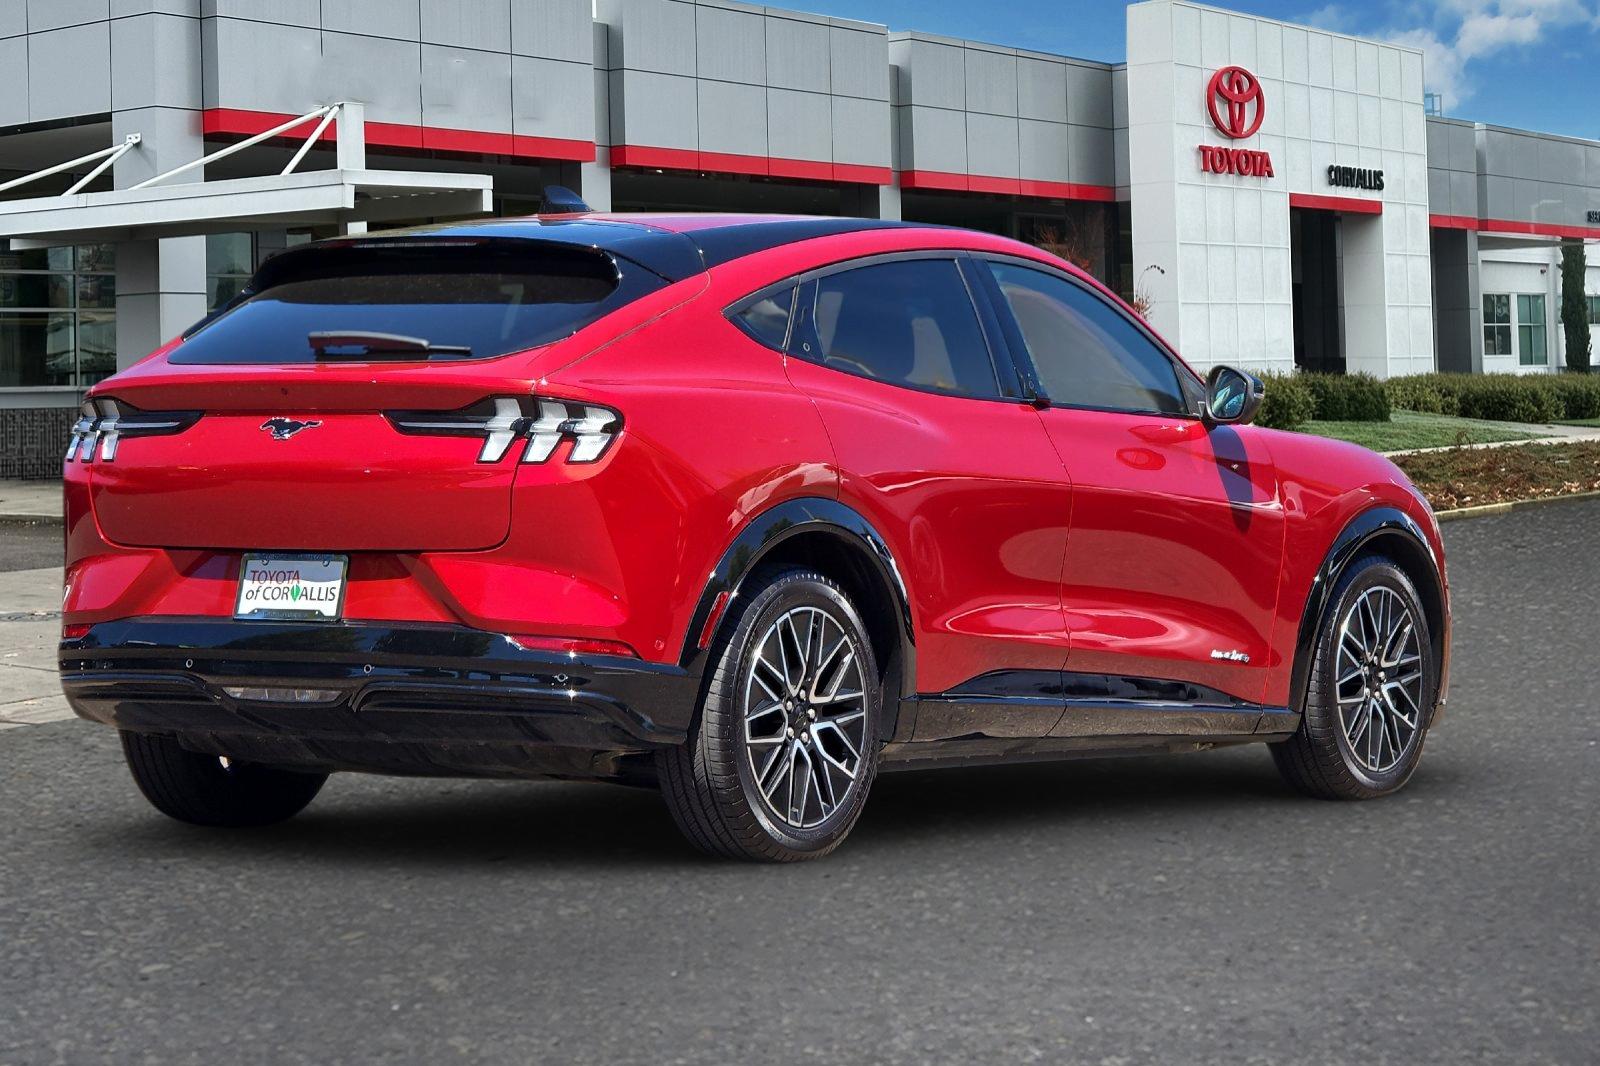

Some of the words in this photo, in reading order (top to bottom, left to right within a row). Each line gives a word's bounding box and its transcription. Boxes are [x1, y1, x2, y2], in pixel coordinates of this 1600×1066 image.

[1199, 145, 1274, 177] TOYOTA
[1327, 164, 1385, 191] CORVALLIS
[250, 570, 301, 585] TOYOTA
[245, 586, 262, 601] of
